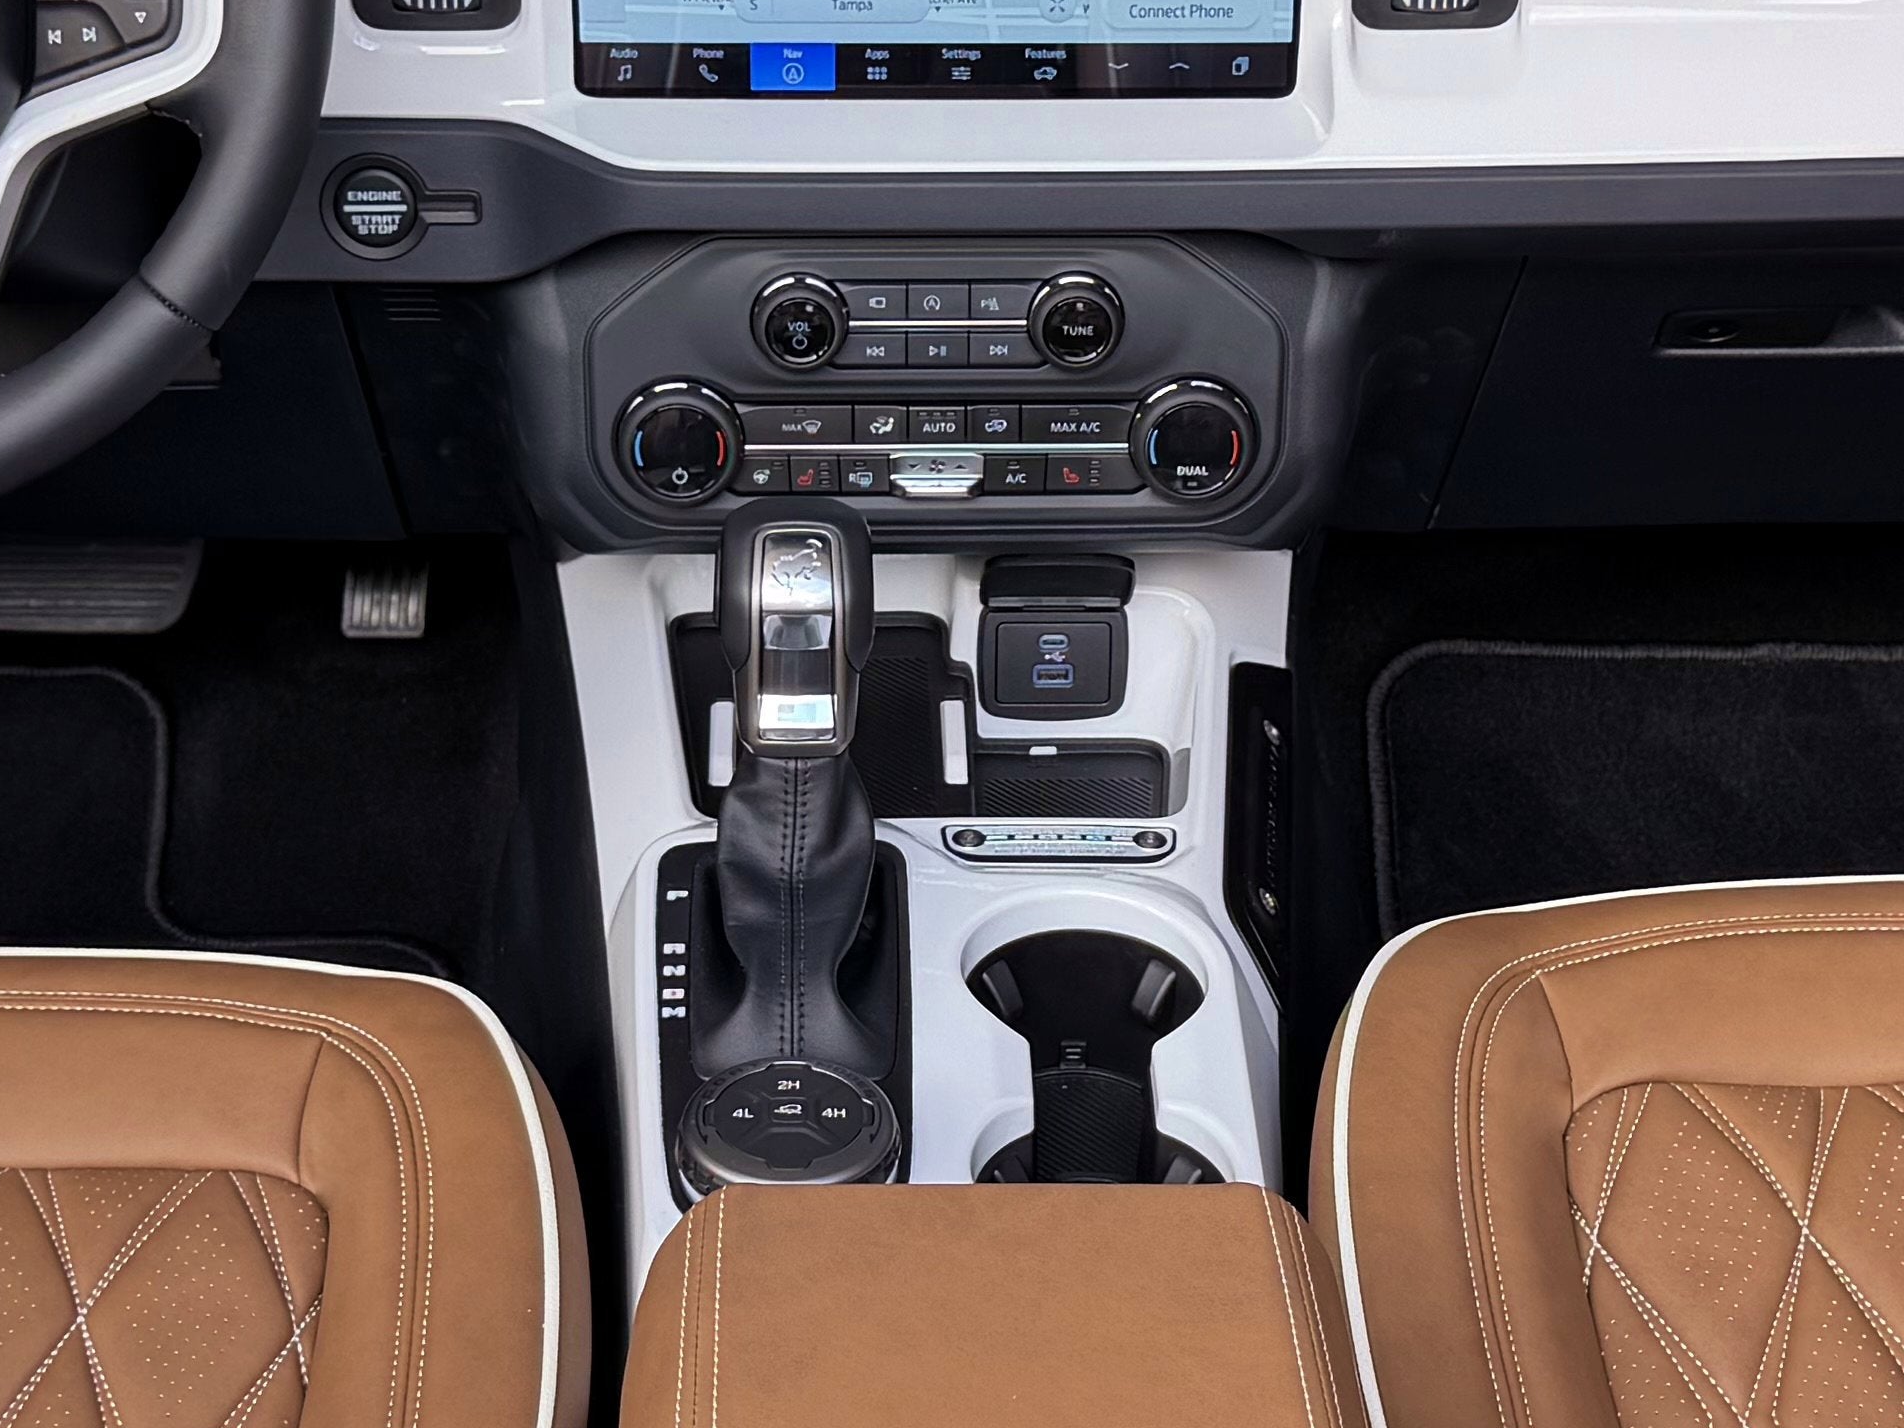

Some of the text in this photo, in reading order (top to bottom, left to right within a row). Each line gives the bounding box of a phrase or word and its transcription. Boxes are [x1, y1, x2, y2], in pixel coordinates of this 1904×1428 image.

[1129, 4, 1234, 19] Connect Phone
[610, 48, 639, 59] Audio
[693, 48, 725, 59] Phone
[783, 49, 803, 59] Nav
[865, 48, 890, 61] Apps
[942, 48, 982, 61] Settings
[1025, 48, 1067, 60] Features
[347, 191, 402, 202] ENGINE
[351, 215, 402, 226] START
[358, 225, 399, 236] STOP
[788, 321, 812, 333] VOL
[1062, 325, 1095, 337] TUNE
[782, 423, 803, 432] MAX
[923, 422, 956, 433] AUTO
[1051, 422, 1101, 433] MAX A/C
[1177, 466, 1209, 477] DUAL
[1005, 473, 1027, 484] A/C
[663, 965, 686, 977] N
[662, 1007, 687, 1018] M
[777, 1080, 800, 1090] 2H
[733, 1109, 754, 1119] 4L
[822, 1108, 847, 1119] 4H
